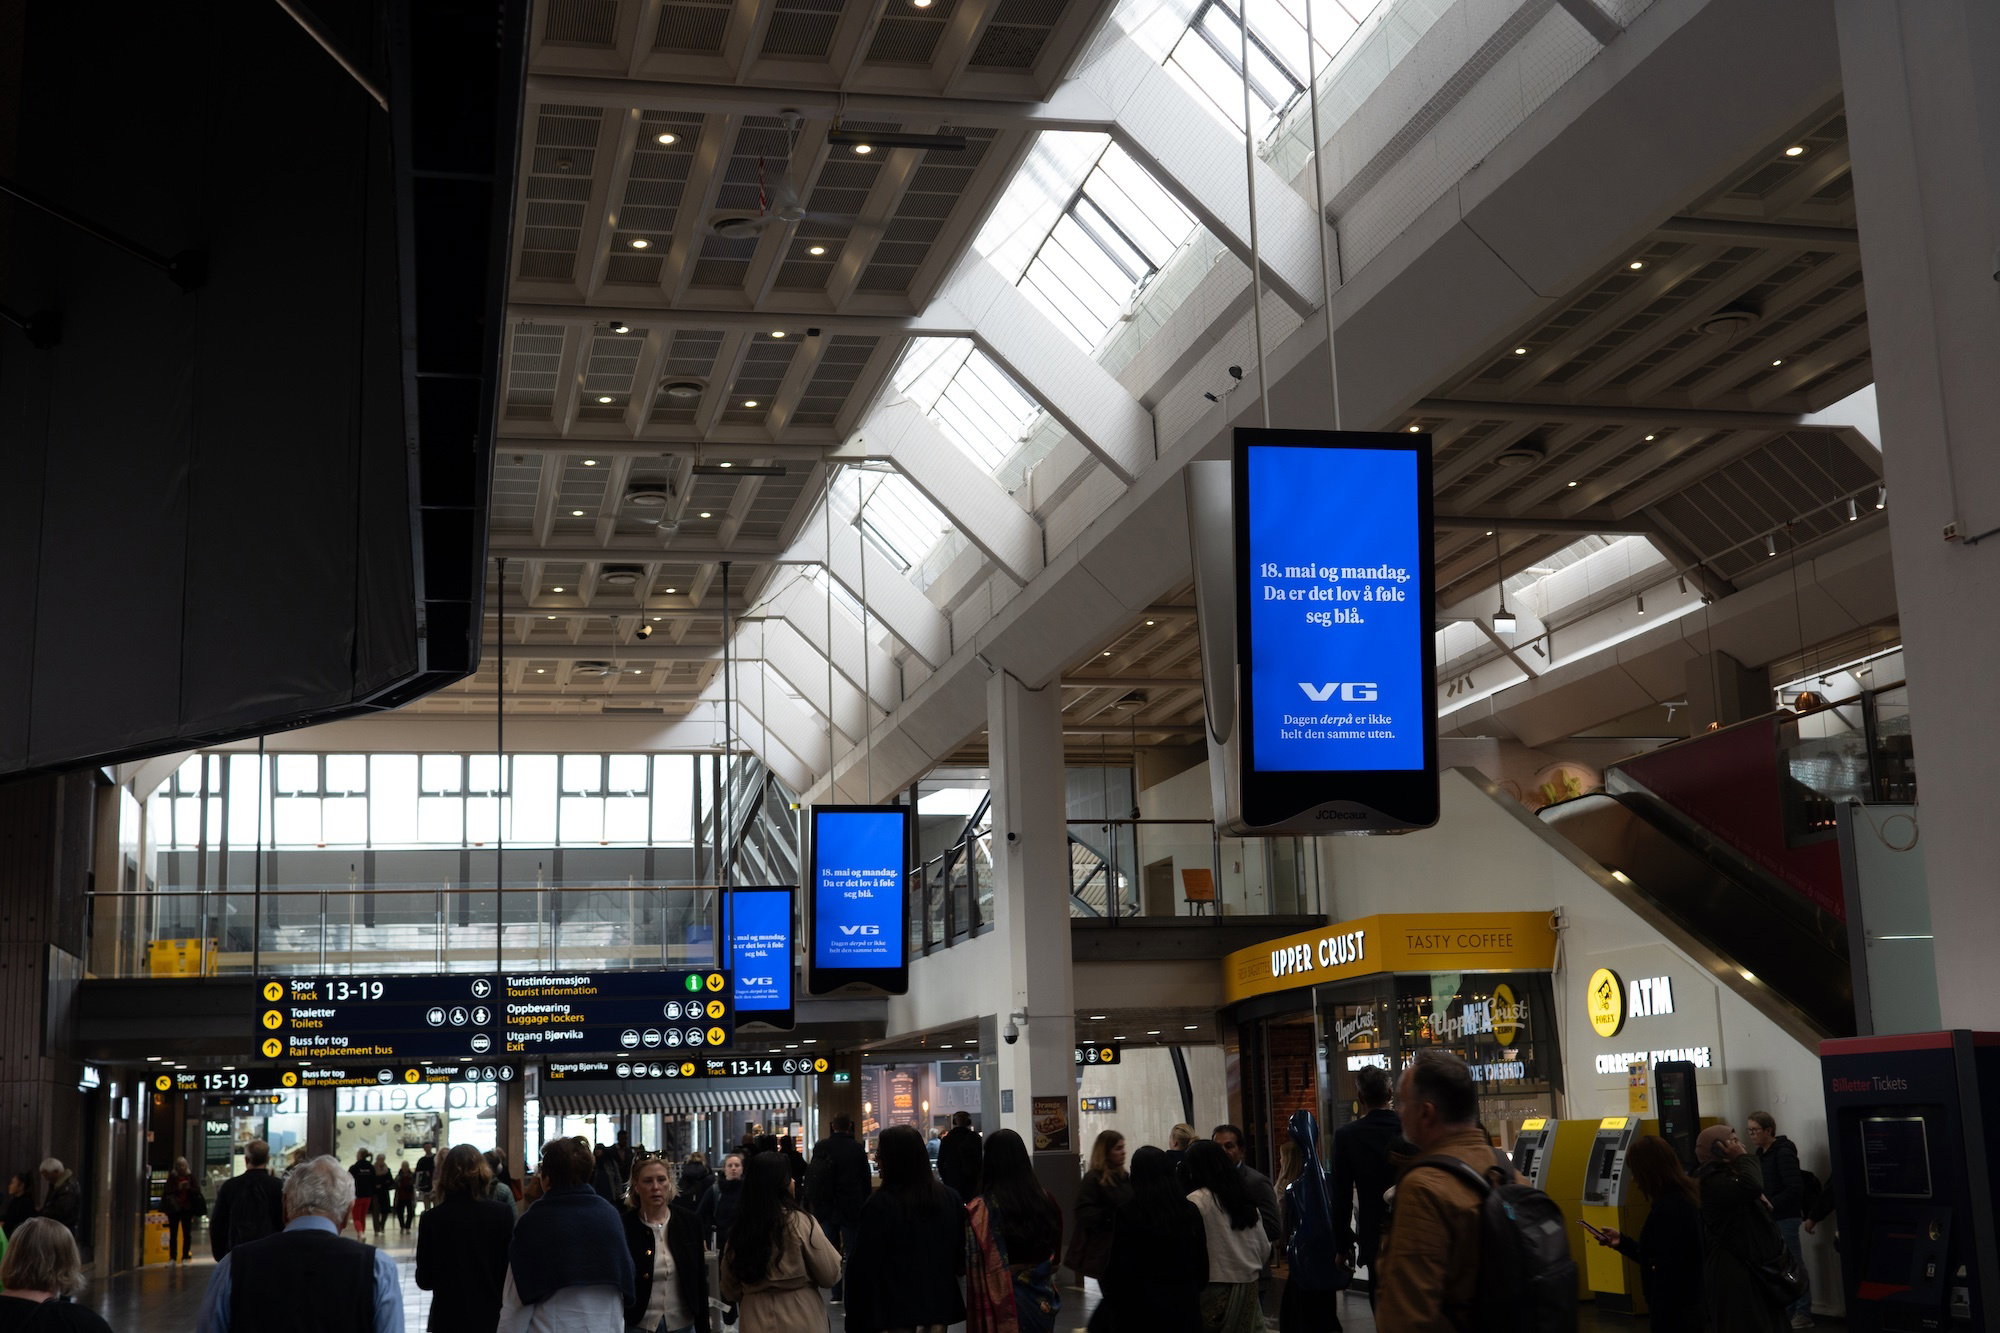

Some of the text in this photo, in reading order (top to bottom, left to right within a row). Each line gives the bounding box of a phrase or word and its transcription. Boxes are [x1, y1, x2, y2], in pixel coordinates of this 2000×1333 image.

[1260, 563, 1411, 583] 18. mai og mandag.
[1264, 584, 1406, 602] Da er det lov å føle
[1306, 607, 1364, 627] seg blå.
[1297, 682, 1378, 702] VG
[1283, 714, 1318, 727] Dagen
[1320, 713, 1353, 727] derpå
[1368, 714, 1392, 724] ikke
[1281, 729, 1396, 739] helt den samme uten.
[1315, 809, 1367, 821] JCDecaux
[822, 868, 898, 878] 18. mai og mandag.
[823, 879, 835, 887] Da
[845, 879, 859, 887] det
[859, 879, 872, 887] lov
[873, 879, 879, 887] å
[844, 889, 874, 899] seg blå.
[839, 925, 879, 935] VG
[1406, 933, 1514, 950] TASTY COFFEE
[1271, 930, 1365, 978] UPPER CRUST
[506, 975, 591, 987] Turistinformasjon
[741, 977, 773, 985] VG
[291, 980, 384, 1001] Spor 13-19
[291, 991, 318, 1001] Track
[506, 986, 598, 997] Tourist information
[1629, 976, 1675, 1018] ATM
[291, 1008, 336, 1019] Toaletter
[506, 1003, 571, 1015] Oppbevaring
[290, 1018, 324, 1029] Toilets
[506, 1012, 585, 1025] Luggage lockers
[1428, 997, 1529, 1041] Upper Crust
[1595, 1014, 1615, 1025] FOREX
[1335, 1006, 1374, 1048] Upper Crust
[289, 1035, 349, 1048] Buss for tog
[506, 1029, 584, 1043] Utgang Bjørvika
[289, 1045, 393, 1058] Rail replacement bus
[506, 1041, 525, 1052] Exit
[426, 1066, 459, 1075] Toaletter
[550, 1061, 608, 1073] Utgang Bjørvika
[706, 1060, 773, 1075] Spor 13-14
[707, 1067, 727, 1076] Track
[302, 1069, 345, 1080] Buss for tog
[426, 1074, 449, 1083] Toilets
[550, 1071, 564, 1079] Exit
[177, 1073, 249, 1089] Spor 15-19
[177, 1081, 198, 1090] Track
[302, 1076, 377, 1086] Rail replacement bus
[1832, 1075, 1908, 1093] Billetter Tickets
[206, 1121, 229, 1134] Nye
